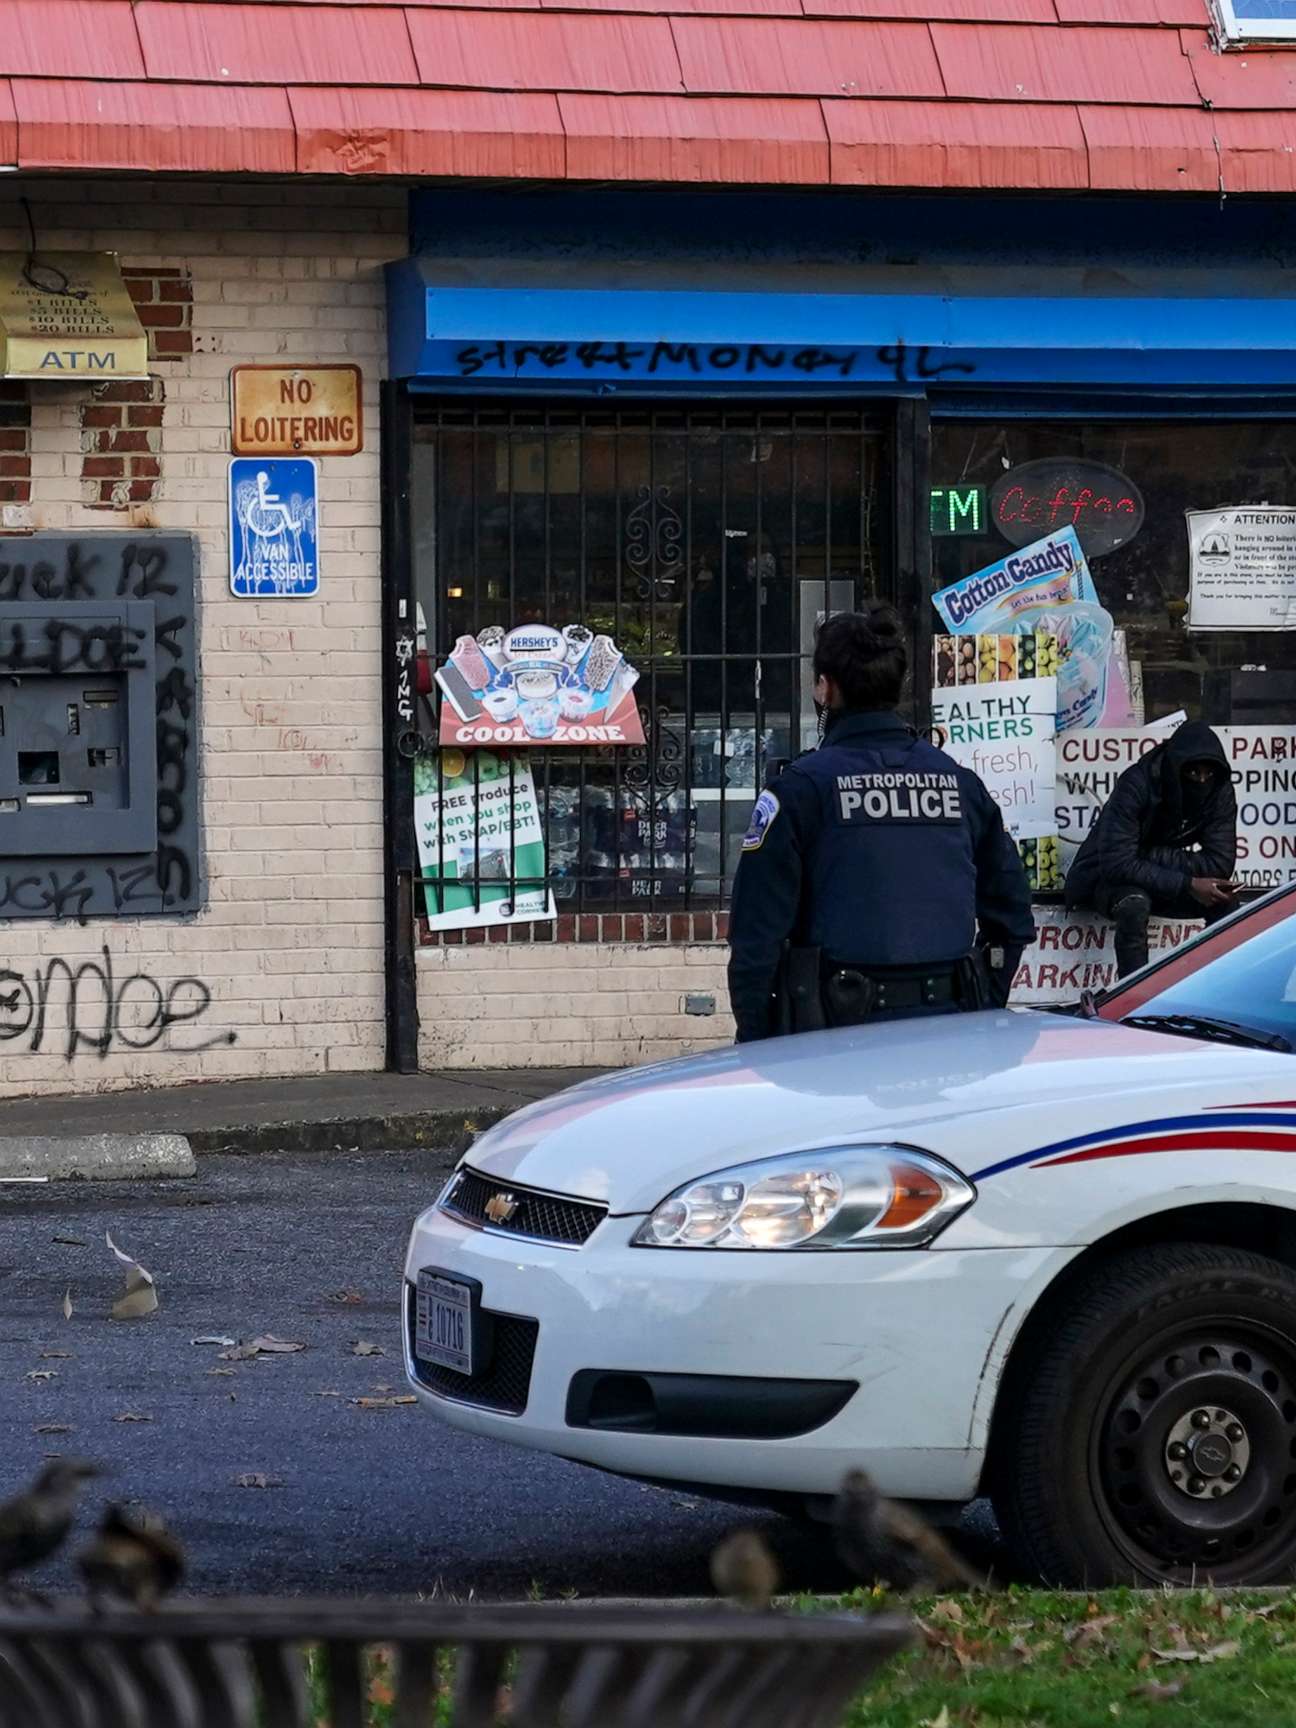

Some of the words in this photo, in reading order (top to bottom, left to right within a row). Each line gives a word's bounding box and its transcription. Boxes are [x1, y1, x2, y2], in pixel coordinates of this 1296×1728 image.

[40, 351, 116, 369] ATM
[279, 378, 313, 405] NO
[239, 416, 354, 443] LOITERING
[1234, 514, 1296, 526] ATTENTION
[260, 543, 289, 561] VAN
[115, 543, 179, 598] 12
[237, 562, 314, 581] ACCESSIBLE
[943, 569, 1011, 625] Cotton
[1006, 540, 1075, 584] Candy
[510, 636, 559, 649] HERSHEY'S
[455, 725, 531, 744] COOL
[550, 724, 627, 743] ZONE
[971, 744, 1039, 775] fresh,
[1062, 737, 1167, 763] CUSTO
[837, 773, 959, 790] METROPOLITAN
[431, 795, 468, 814] FREE
[839, 789, 963, 820] POLICE
[423, 814, 465, 833] wen
[1010, 961, 1118, 990] ARKIN
